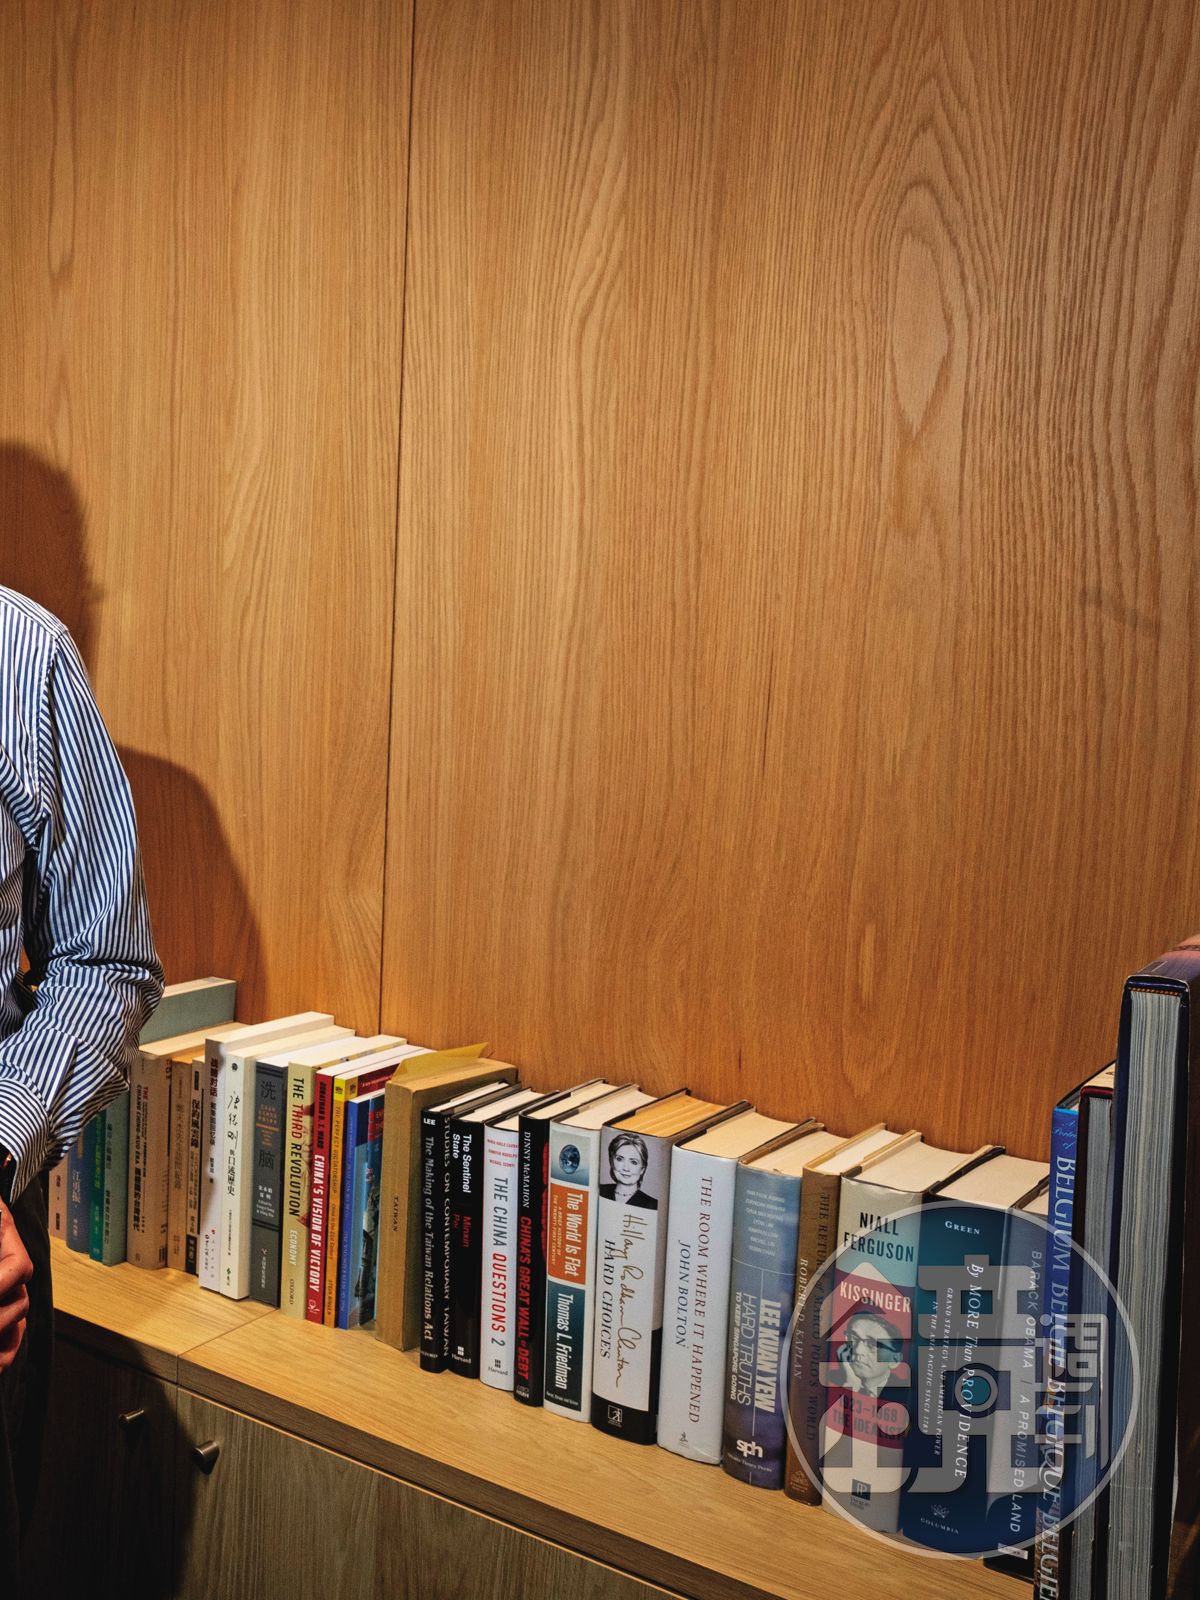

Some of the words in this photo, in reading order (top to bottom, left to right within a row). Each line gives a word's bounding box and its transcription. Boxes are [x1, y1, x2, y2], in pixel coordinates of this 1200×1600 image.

[293, 1078, 304, 1100] THE
[292, 1104, 304, 1139] THIRD
[424, 1118, 436, 1126] LEE
[426, 1137, 434, 1155] The
[452, 1133, 460, 1159] State
[462, 1134, 472, 1152] The
[523, 1131, 531, 1162] DINNY
[289, 1142, 302, 1217] REVOLUTION
[424, 1158, 434, 1195] Making
[444, 1172, 451, 1193] ON
[462, 1154, 472, 1193] Sentinel
[494, 1177, 508, 1202] THE
[522, 1162, 530, 1208] McMAHON
[425, 1198, 434, 1211] of
[566, 1193, 583, 1211] The
[700, 1176, 713, 1207] THE
[819, 1193, 830, 1220] THE
[311, 1198, 323, 1231] VISION
[425, 1211, 434, 1229] the
[493, 1206, 508, 1246] CHINA
[566, 1213, 582, 1243] World
[859, 1212, 899, 1236] NIALL
[1052, 1155, 1076, 1270] BELGIUM
[289, 1230, 298, 1266] ECONOMY
[311, 1233, 322, 1247] OF
[463, 1216, 471, 1248] Minxin
[697, 1212, 710, 1258] ROOM
[844, 1231, 914, 1262] FERGUSON
[424, 1232, 434, 1268] Taiwan
[565, 1244, 581, 1255] Is
[603, 1239, 616, 1286] HARD
[678, 1240, 691, 1284] JOHN
[310, 1250, 321, 1292] VICTORY
[564, 1256, 581, 1277] Flat
[967, 1264, 984, 1278] By
[1027, 1250, 1043, 1311] BARACK
[424, 1270, 434, 1319] Relations
[491, 1253, 507, 1333] QUESTIONS
[518, 1265, 530, 1305] GREAT
[694, 1264, 708, 1318] WHERE
[736, 1292, 742, 1304] TO
[797, 1258, 809, 1309] ROBERT
[840, 1281, 911, 1313] KISSINGER
[557, 1293, 574, 1332] Thomas
[676, 1286, 689, 1347] BOLTON
[740, 1293, 758, 1339] HARD
[760, 1299, 781, 1330] LEE
[932, 1301, 939, 1310] IN
[945, 1288, 953, 1316] GRAND
[966, 1284, 982, 1329] MORE
[424, 1322, 434, 1341] Act
[517, 1307, 530, 1338] WALL
[556, 1332, 573, 1341] L.
[600, 1291, 614, 1359] CHOICES
[693, 1322, 705, 1339] IT
[930, 1314, 938, 1328] THE
[491, 1337, 506, 1347] 2
[732, 1327, 740, 1373] SINGAPORE
[757, 1327, 780, 1374] KUAN
[794, 1329, 805, 1378] KAPLAN
[942, 1319, 952, 1360] STRATEGY
[963, 1336, 978, 1362] Than
[1023, 1317, 1036, 1368] OBAMA
[488, 1366, 508, 1376] Harvard
[517, 1347, 529, 1380] DEBT
[555, 1343, 572, 1390] Friedman
[737, 1343, 754, 1406] TRUTHS
[926, 1354, 934, 1386] PACIFIC
[688, 1343, 704, 1423] HAPPENED
[754, 1374, 777, 1414] YEW
[1020, 1394, 1031, 1404] A
[924, 1389, 932, 1412] SINCE
[936, 1384, 946, 1424] AMERICAN
[833, 1409, 850, 1428] THE
[854, 1419, 904, 1440] IDEALIST
[954, 1368, 975, 1478] PROVIDENCE
[736, 1439, 763, 1458] sph
[934, 1428, 942, 1456] POWER
[1013, 1410, 1029, 1488] PROMISED
[920, 1517, 959, 1534] COLUMBIA
[1010, 1494, 1023, 1533] LAND
[1039, 1510, 1060, 1600] BELGIE
